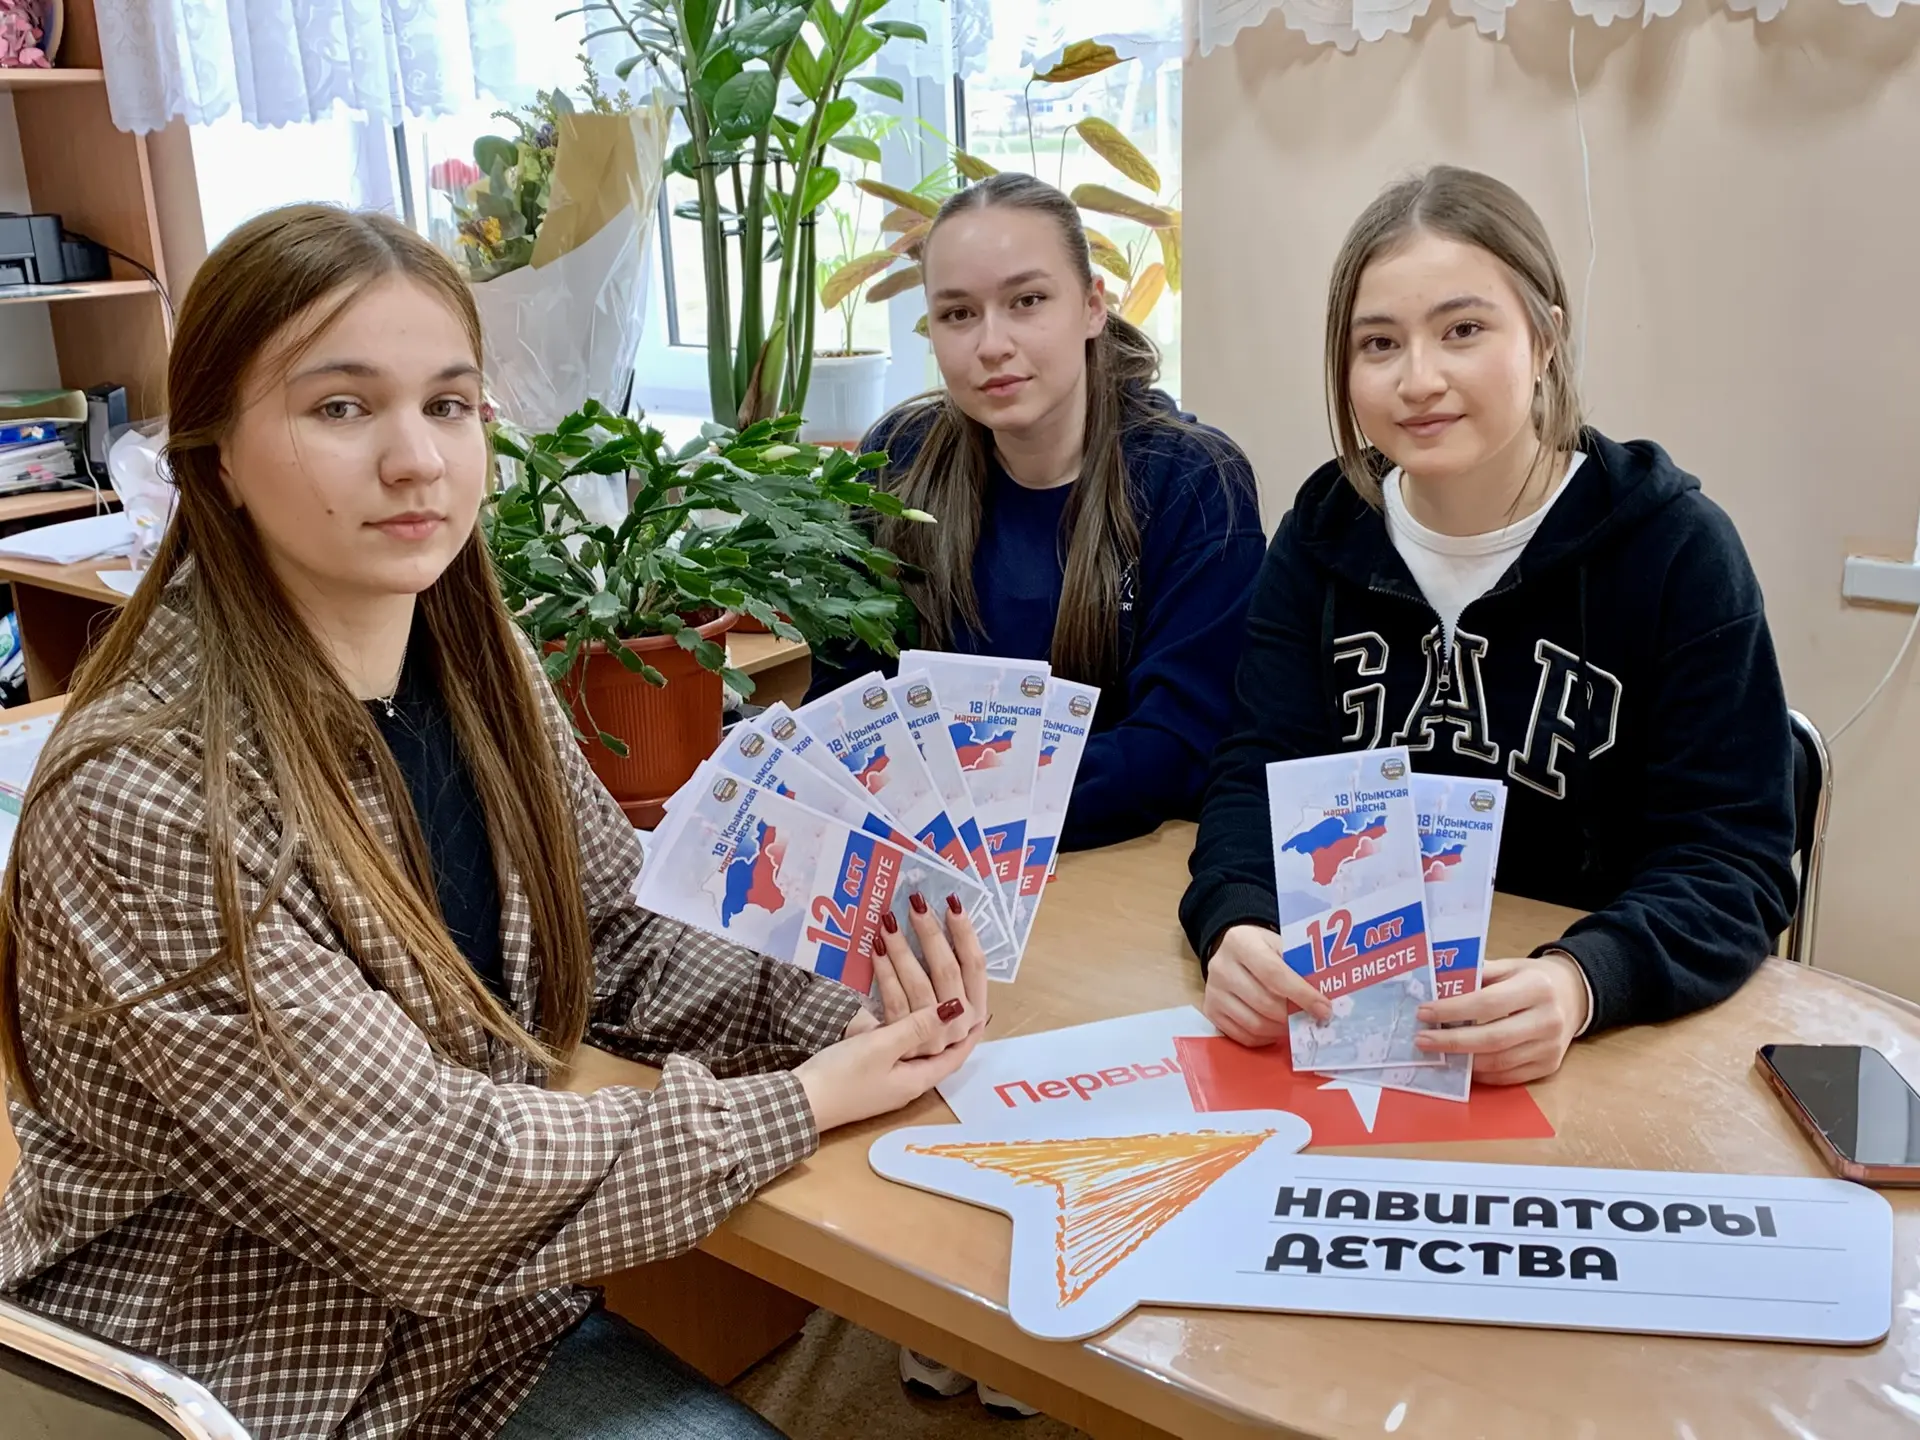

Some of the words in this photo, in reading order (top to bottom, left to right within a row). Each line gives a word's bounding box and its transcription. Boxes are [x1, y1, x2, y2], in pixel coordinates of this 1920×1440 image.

[907, 712, 941, 730] мская
[954, 713, 981, 723] марта
[987, 714, 1018, 726] весна
[969, 701, 983, 714] 18
[988, 702, 1042, 717] Крымская
[1333, 624, 1622, 800] GAP
[826, 738, 843, 754] 18
[845, 711, 899, 743] Крымская
[851, 732, 882, 753] весна
[1042, 731, 1061, 743] сна
[1043, 719, 1085, 737] рымская
[752, 747, 784, 785] ымская
[1323, 808, 1349, 817] марта
[1355, 801, 1387, 814] весна
[1335, 794, 1349, 806] 18
[1355, 787, 1409, 803] Крымская
[712, 842, 728, 857] 18
[721, 788, 759, 839] Крымская
[1417, 814, 1430, 828] 18
[1437, 815, 1493, 832] Крымская
[1435, 828, 1467, 840] весна
[718, 847, 737, 874] марта
[734, 813, 756, 844] весна
[866, 855, 894, 925] ВМЕСТЕ
[806, 895, 858, 952] 12
[1306, 908, 1358, 973] 12
[857, 926, 876, 958] МЫ
[1433, 947, 1459, 969] ЕТ
[1320, 972, 1347, 994] МЫ
[1352, 946, 1417, 983] ВМЕСТЕ
[993, 1056, 1183, 1109] Первы
[1274, 1186, 1777, 1237] НАВИГАТОРЫ
[1264, 1233, 1618, 1281] ДЕТСТВА
